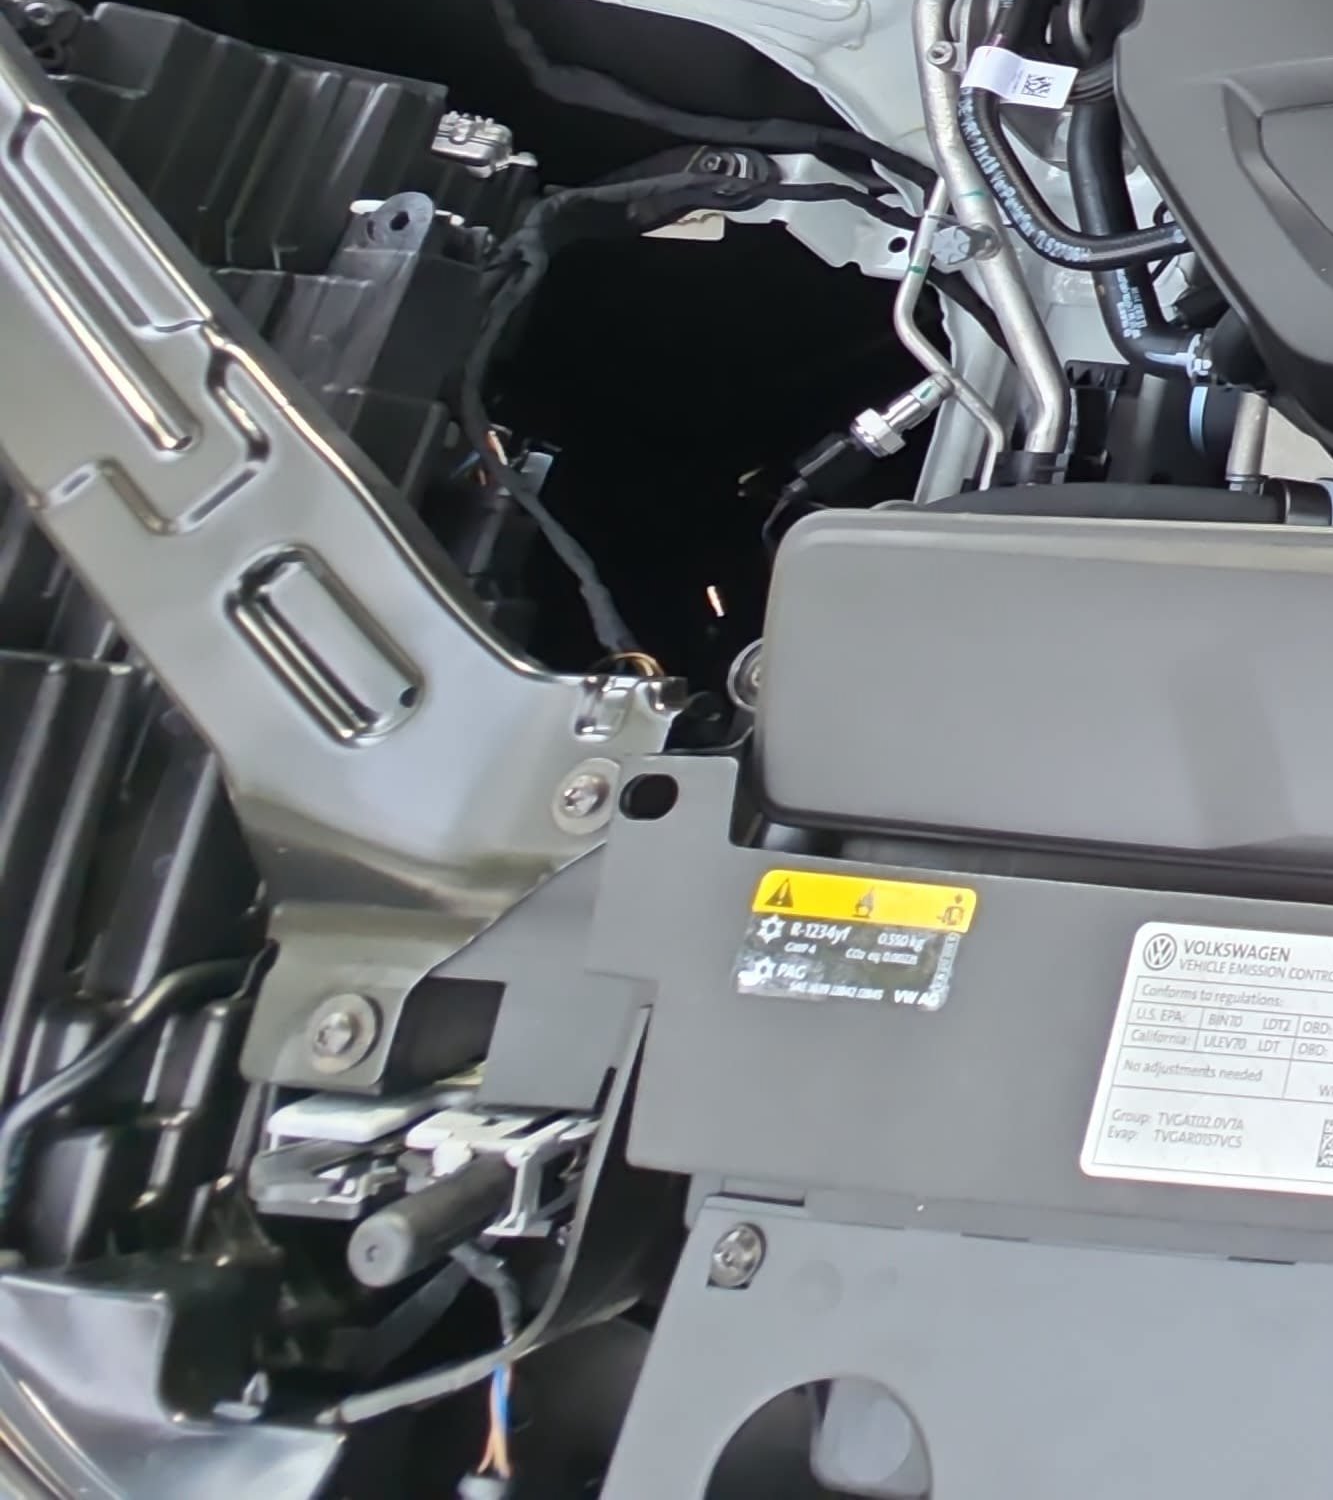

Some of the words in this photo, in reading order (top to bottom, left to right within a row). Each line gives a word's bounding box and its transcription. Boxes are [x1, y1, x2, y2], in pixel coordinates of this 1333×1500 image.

[790, 922, 852, 945] R-1234yf
[910, 934, 928, 952] kg
[1184, 939, 1290, 962] VOLKSWAGEN
[777, 963, 807, 980] PAG
[1179, 958, 1225, 974] VEHICLE
[1228, 962, 1286, 979] EMISSION
[894, 990, 917, 1005] VW
[1142, 984, 1197, 1000] Conforms
[1208, 1014, 1242, 1027] BIN70
[1263, 1018, 1292, 1031] LDT2
[1303, 1020, 1332, 1035] OBD:
[1203, 1035, 1247, 1050] ULEV70
[1258, 1039, 1280, 1052] LDT
[1299, 1043, 1328, 1057] OBD:
[1124, 1059, 1141, 1072] No
[1143, 1061, 1216, 1079] adjustments
[1219, 1068, 1263, 1082] needed
